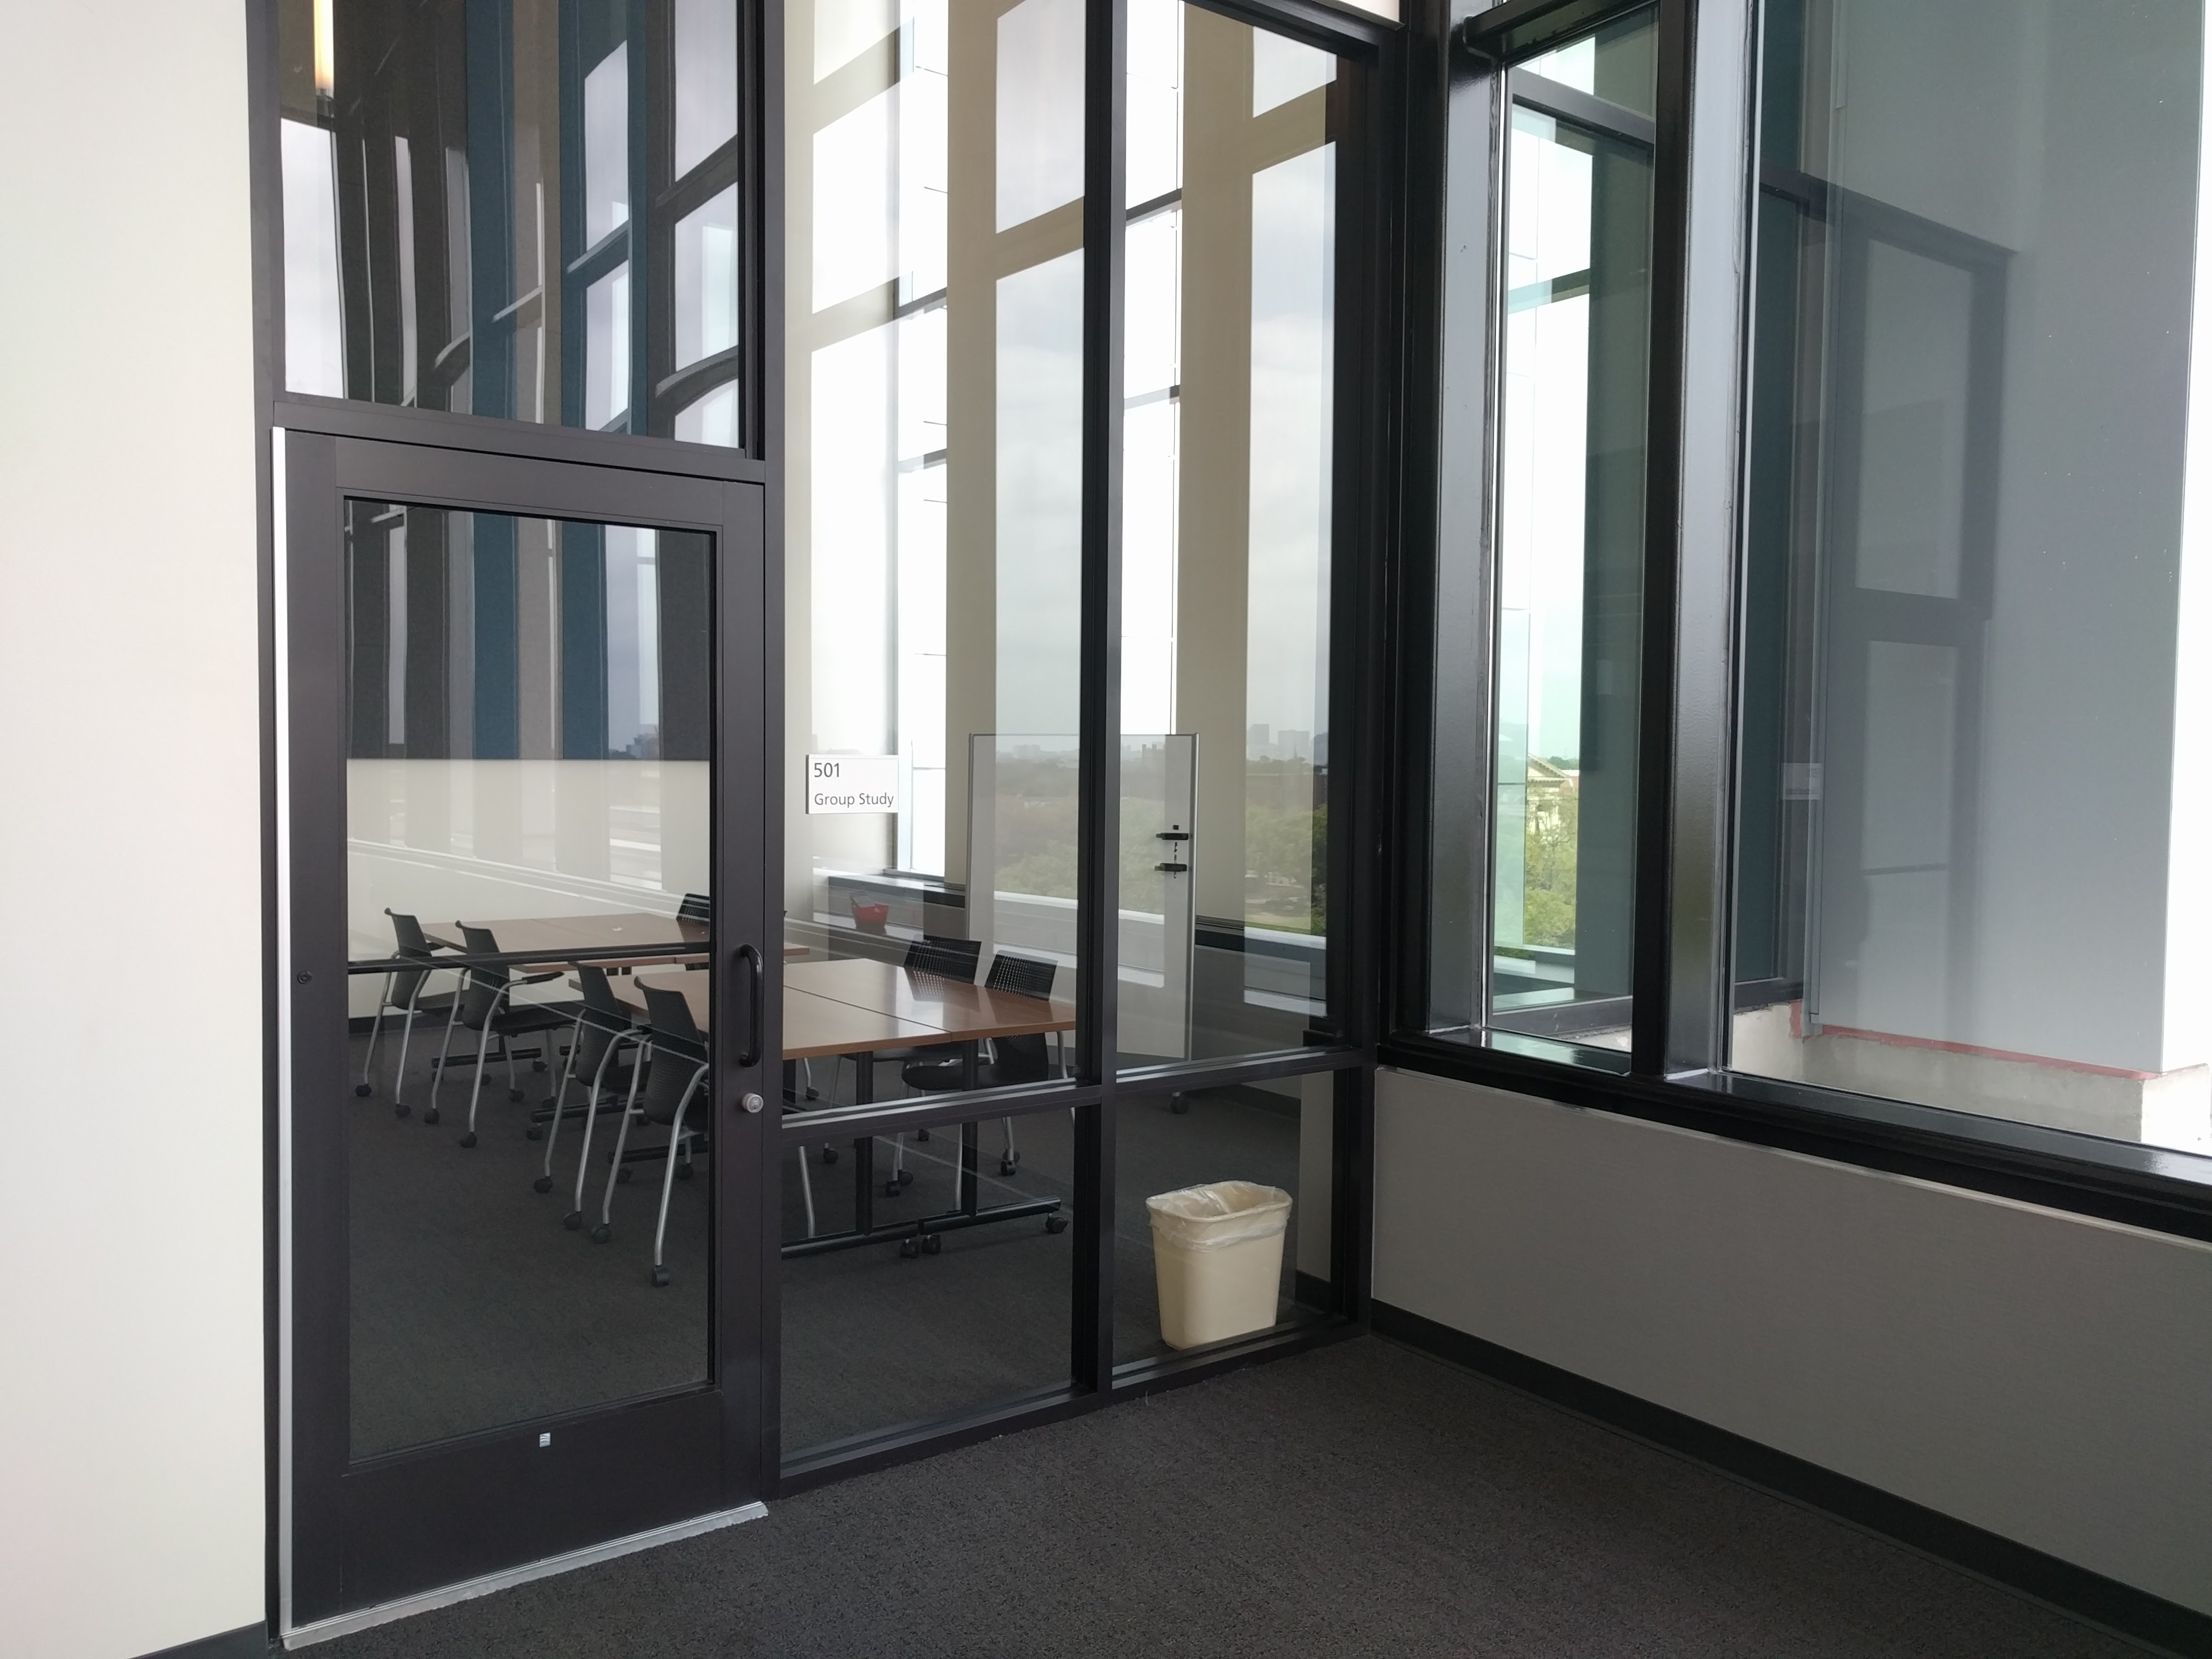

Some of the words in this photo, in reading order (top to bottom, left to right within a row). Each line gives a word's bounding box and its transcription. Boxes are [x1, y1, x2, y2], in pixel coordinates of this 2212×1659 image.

[814, 763, 839, 777] 501
[814, 793, 855, 808] Group
[859, 792, 894, 808] Study
